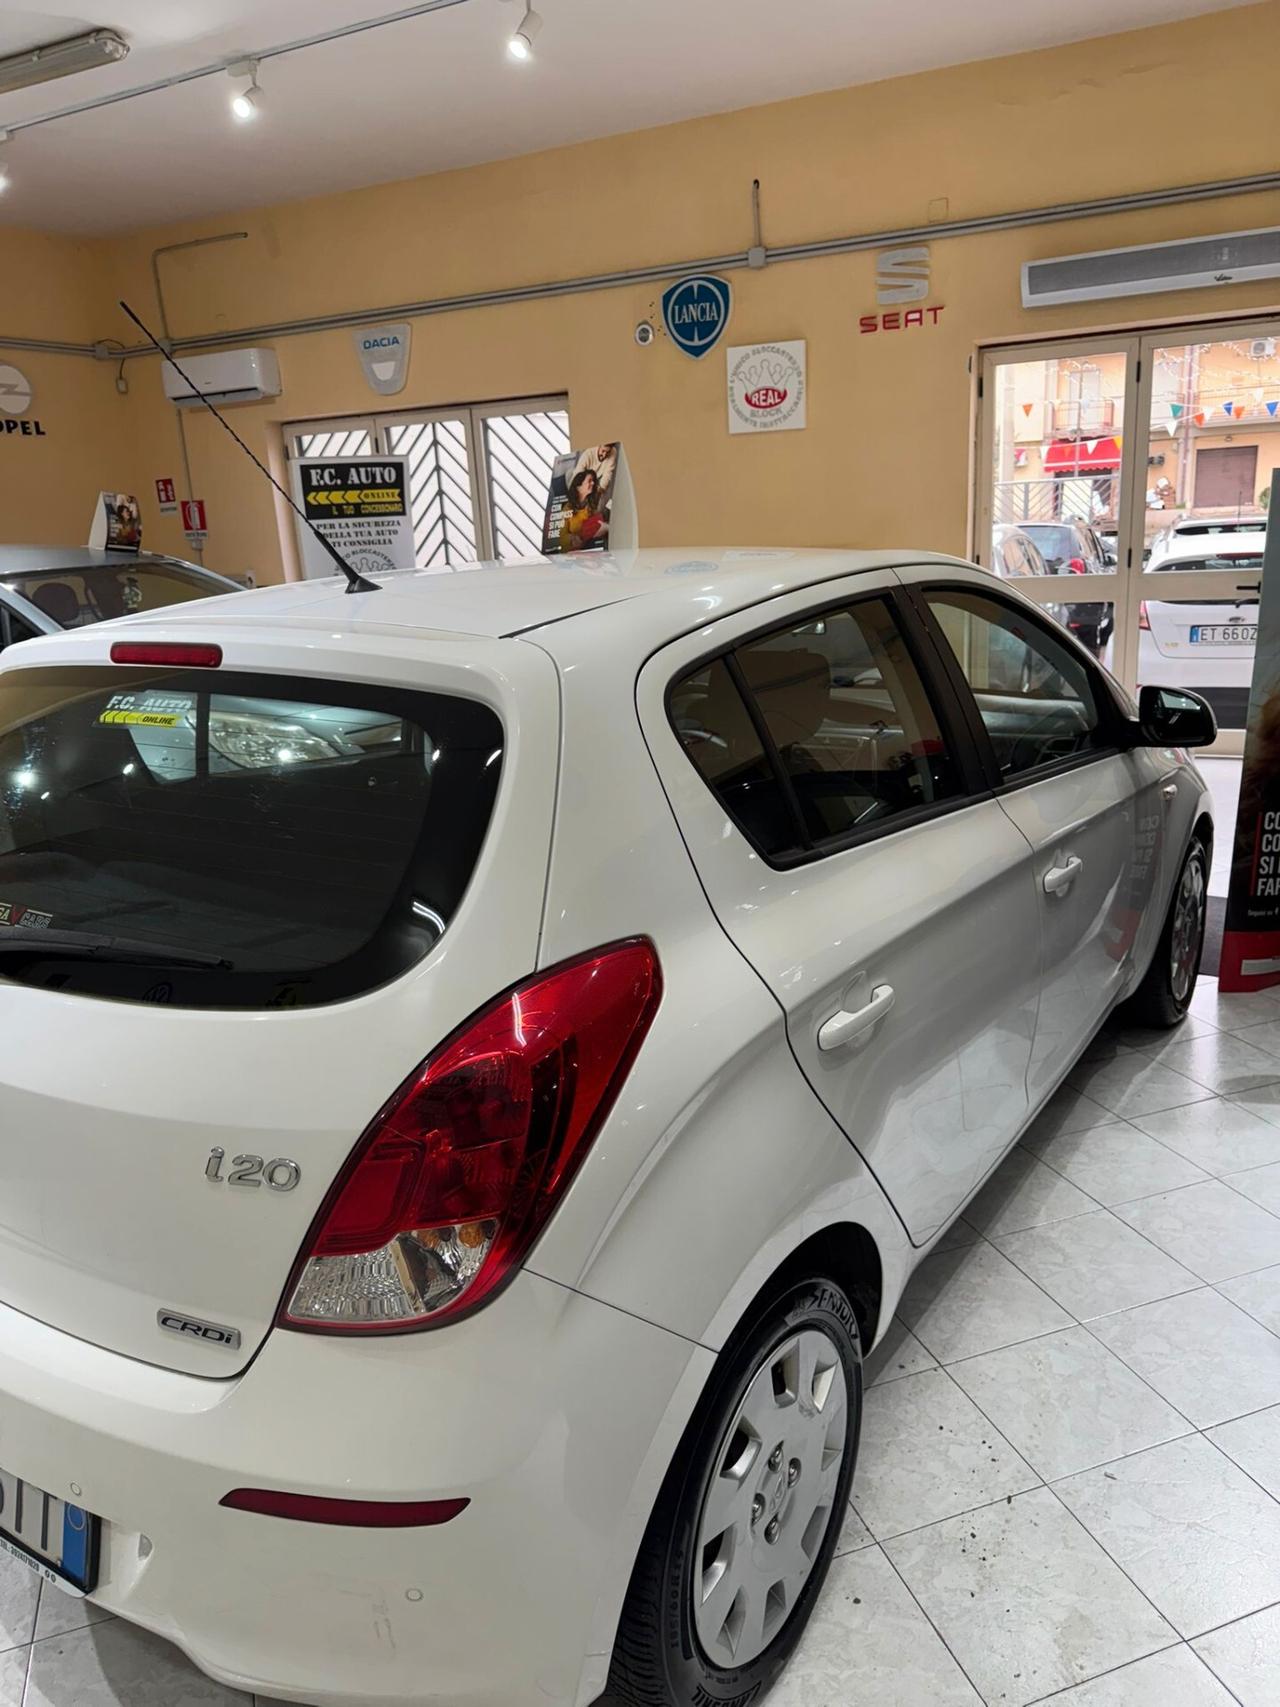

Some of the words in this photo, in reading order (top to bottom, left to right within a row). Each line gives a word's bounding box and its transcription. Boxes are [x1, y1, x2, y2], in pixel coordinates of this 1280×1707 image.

[674, 301, 720, 324] LANCIA
[859, 306, 945, 334] SEAT
[362, 335, 400, 351] DACIA
[751, 389, 781, 406] REAL
[347, 466, 397, 485] AUTO
[363, 491, 396, 500] ONLINE
[316, 522, 336, 531] PER
[338, 522, 350, 530] LA
[352, 520, 402, 530] SICUREZZA
[354, 530, 373, 538] TUA
[375, 529, 399, 537] AUTO
[343, 538, 394, 548] CONSIGLIA
[1200, 628, 1217, 641] ET
[142, 715, 175, 725] ONLINE
[205, 1145, 302, 1192] i20
[161, 1316, 233, 1344] CRDi
